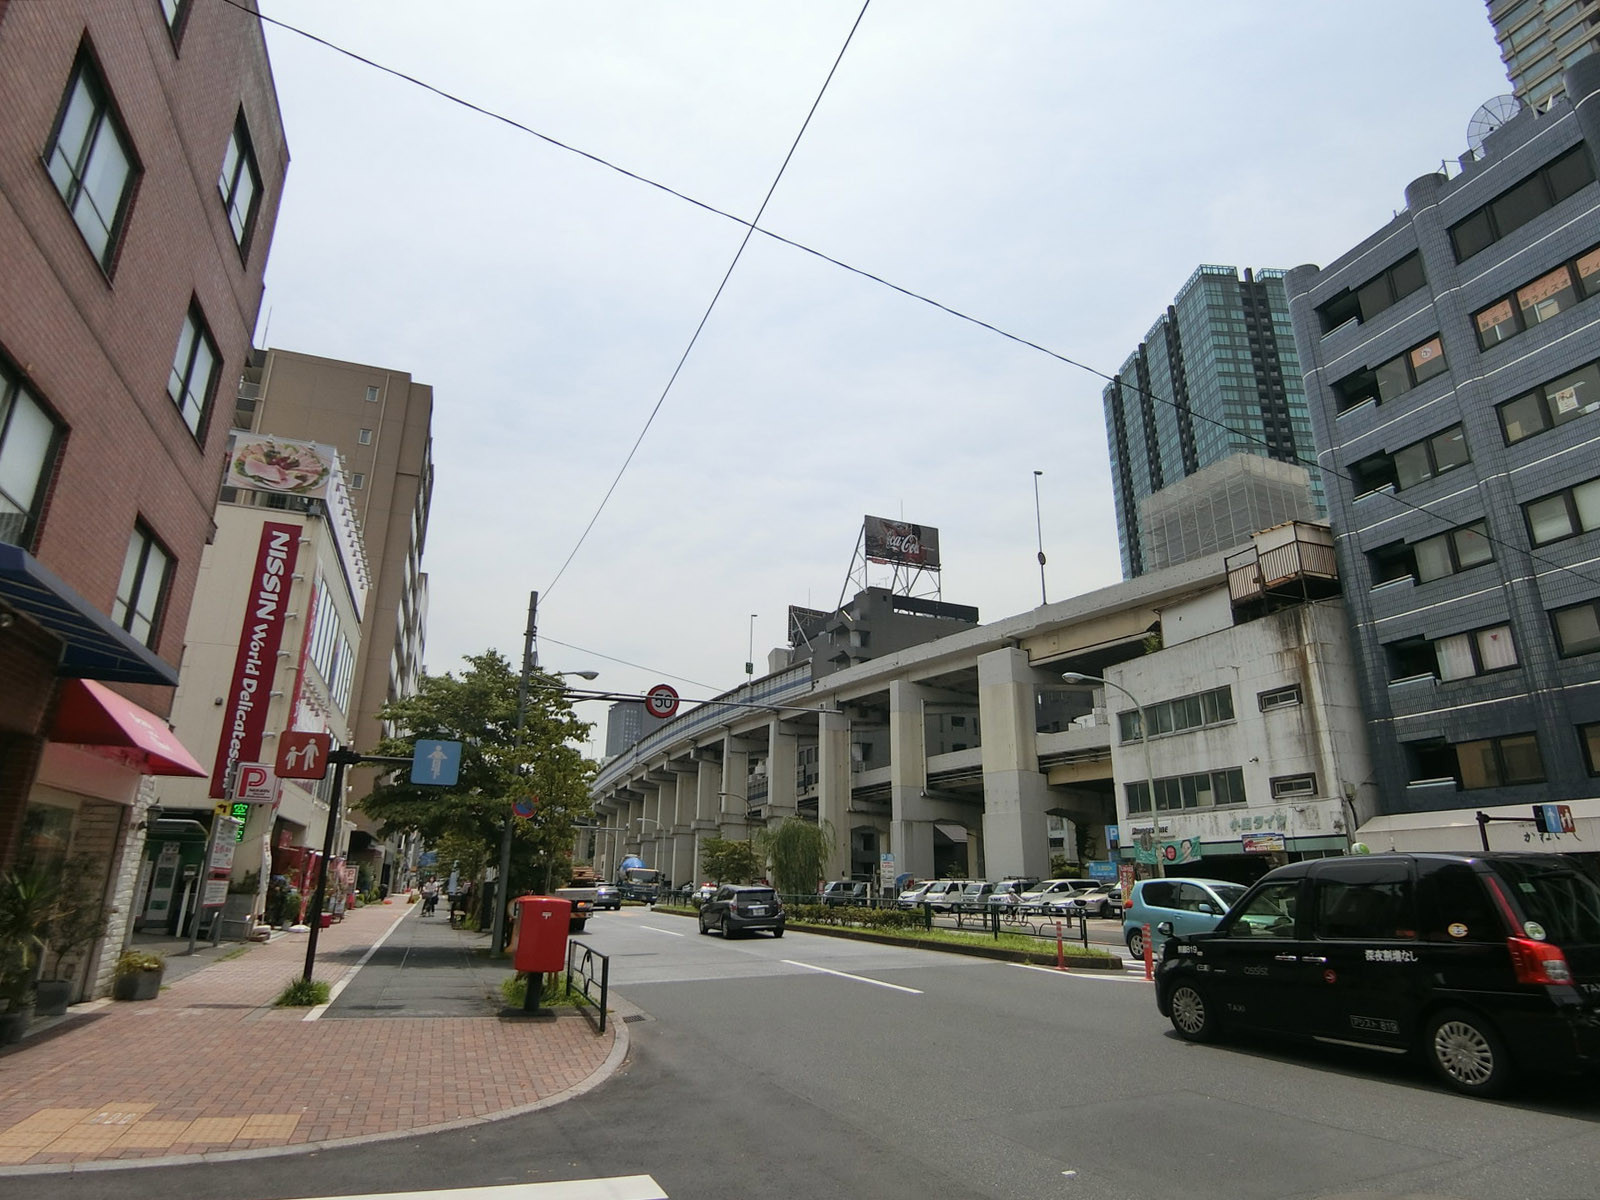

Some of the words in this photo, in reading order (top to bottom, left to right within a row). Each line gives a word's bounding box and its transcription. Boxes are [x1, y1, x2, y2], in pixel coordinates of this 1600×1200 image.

[886, 531, 920, 554] Coca-Cola
[256, 530, 290, 620] NISSIN
[245, 623, 269, 676] World
[655, 694, 672, 709] 50
[238, 768, 267, 798] P
[1132, 825, 1168, 836] BRIDGESNE
